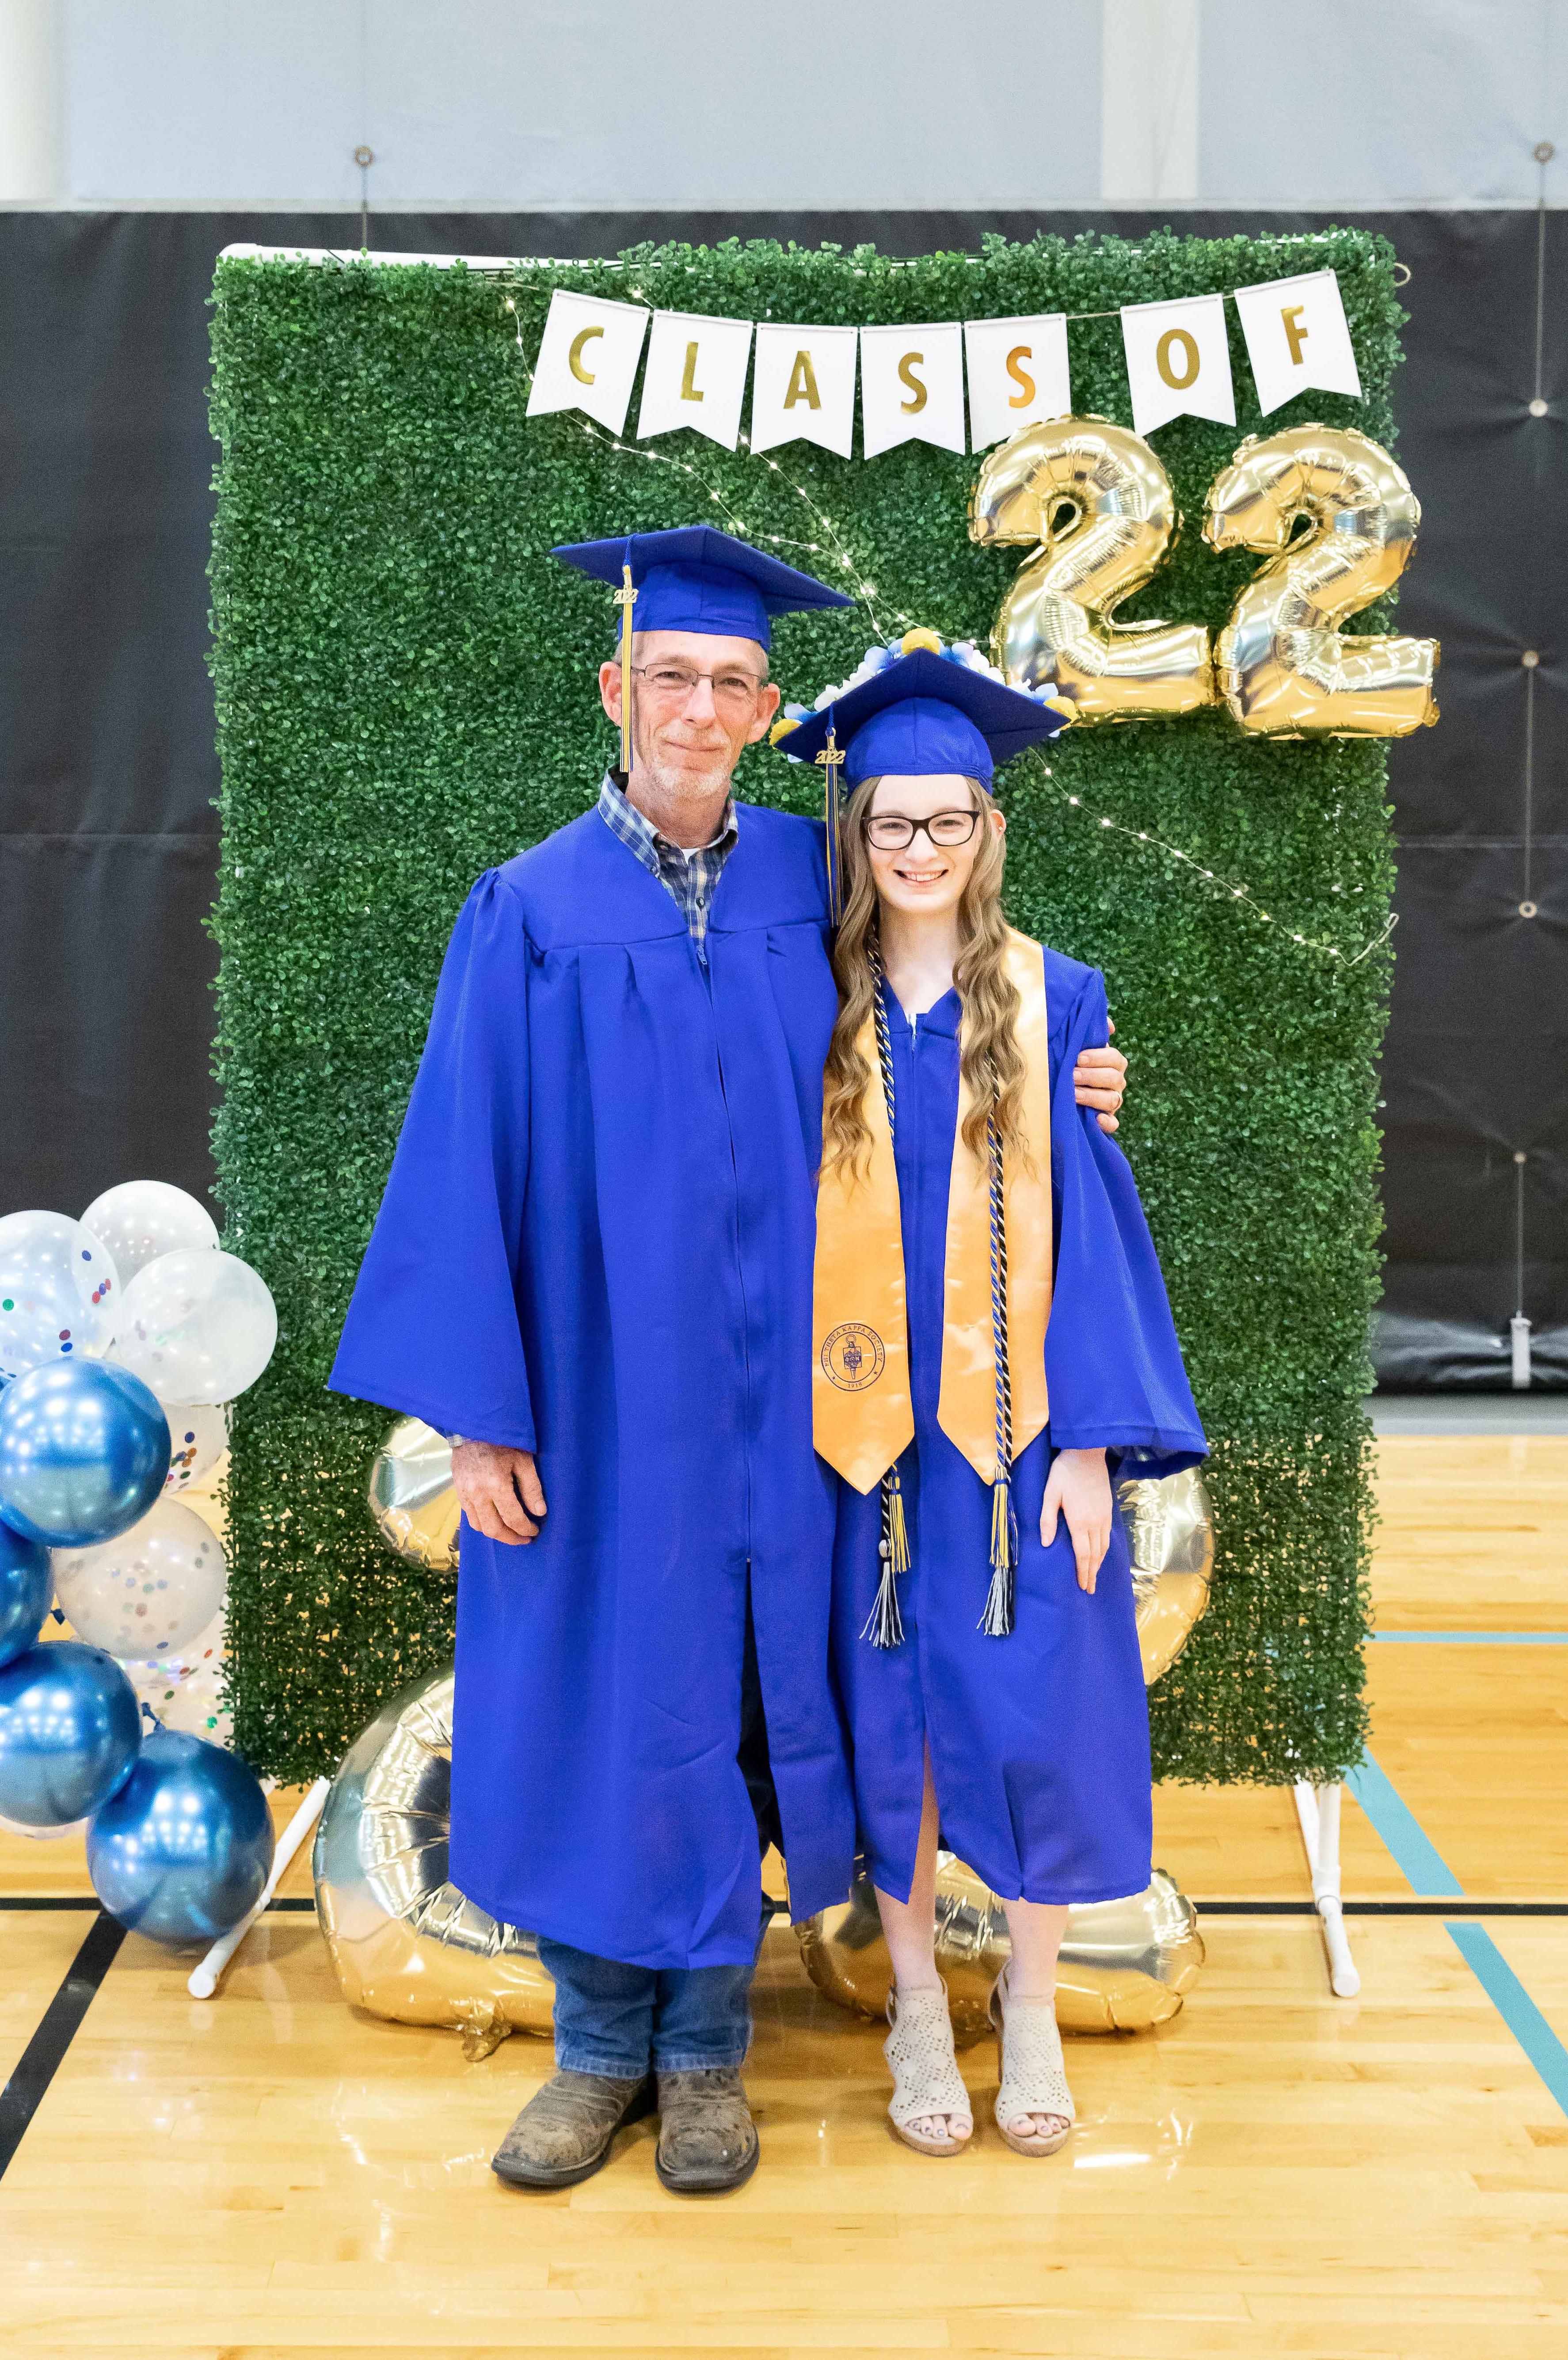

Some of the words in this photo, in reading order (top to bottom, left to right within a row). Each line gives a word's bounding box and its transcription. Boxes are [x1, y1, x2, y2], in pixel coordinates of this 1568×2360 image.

[568, 325, 1036, 415] CLASS
[1155, 304, 1309, 389] OF
[967, 413, 1441, 740] 22
[815, 750, 846, 764] 2022
[868, 1332, 883, 1362] SOCIETY
